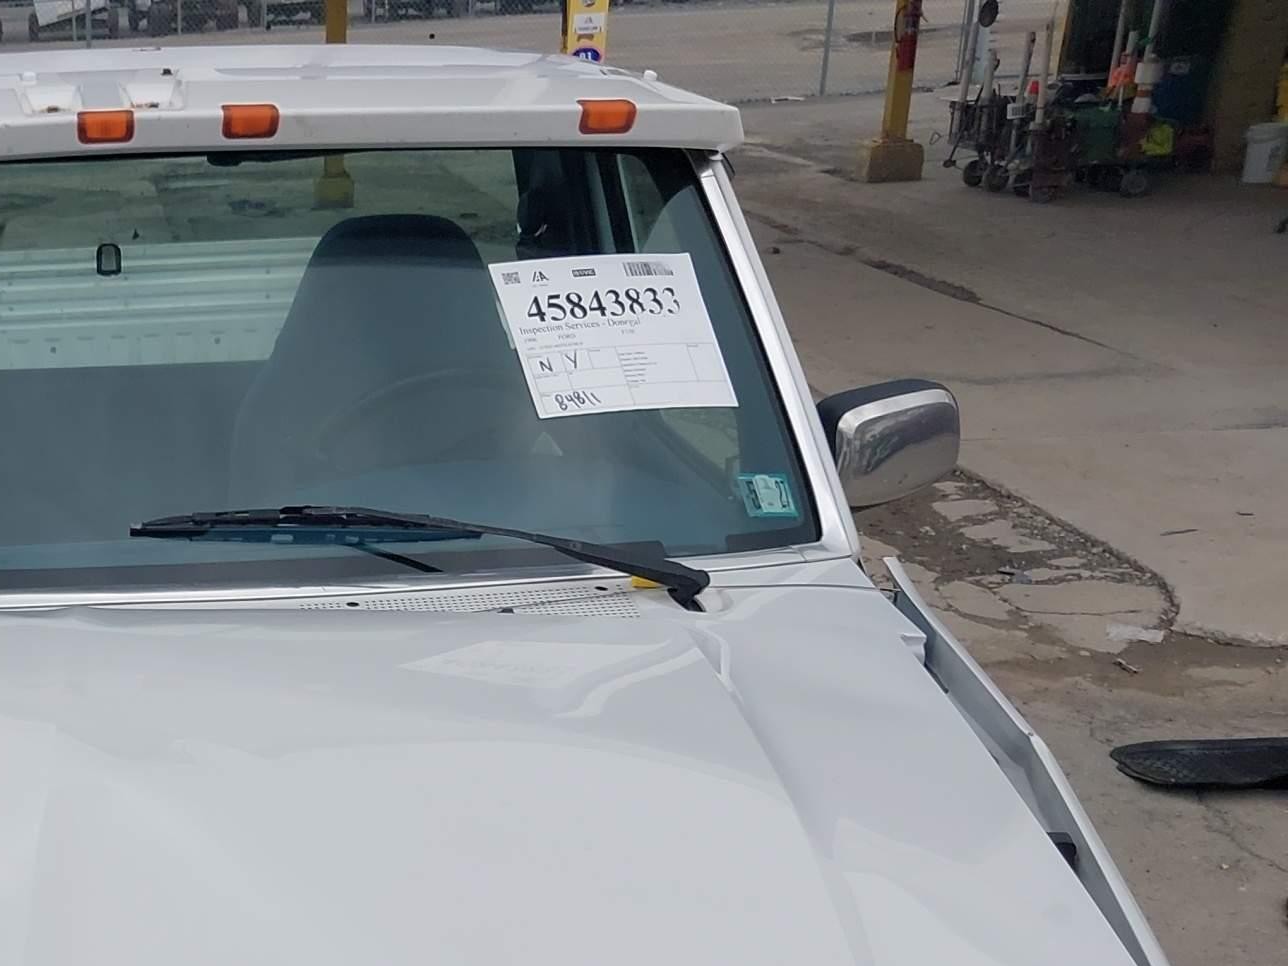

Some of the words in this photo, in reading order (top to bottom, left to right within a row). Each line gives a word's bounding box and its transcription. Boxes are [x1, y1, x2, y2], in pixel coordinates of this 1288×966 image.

[527, 287, 681, 323] 45843833
[519, 323, 564, 336] Inspection
[565, 321, 601, 331] Services
[538, 357, 554, 373] N
[564, 350, 578, 369] Y
